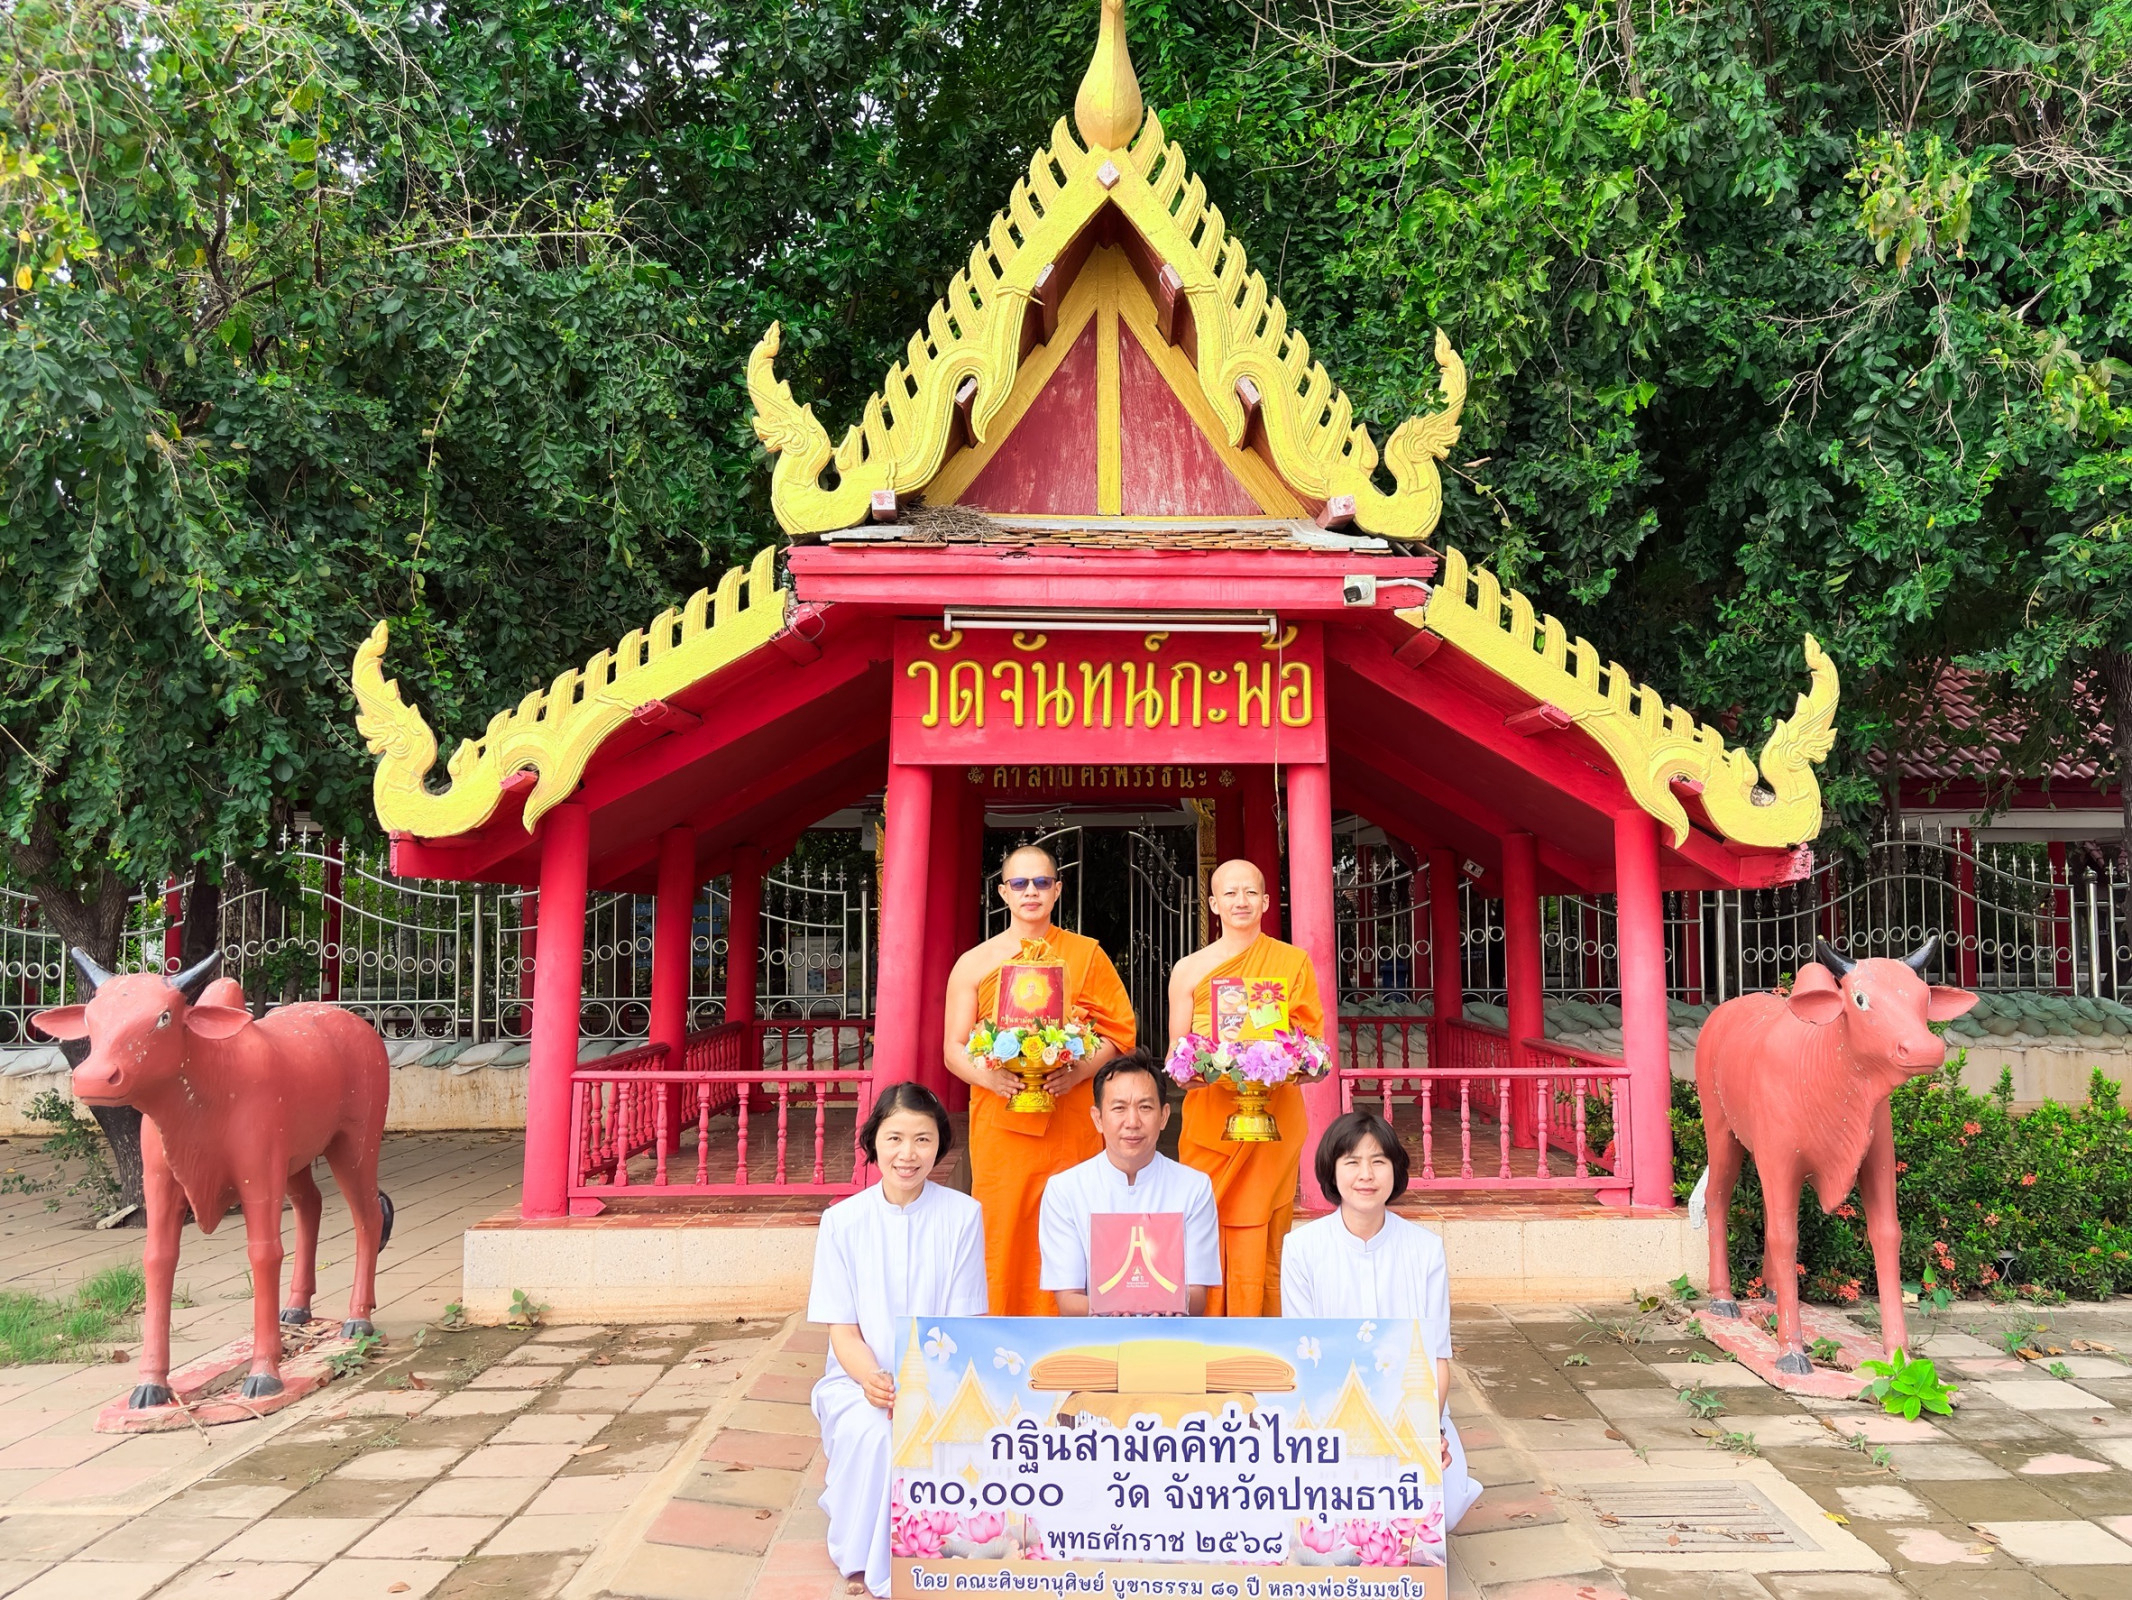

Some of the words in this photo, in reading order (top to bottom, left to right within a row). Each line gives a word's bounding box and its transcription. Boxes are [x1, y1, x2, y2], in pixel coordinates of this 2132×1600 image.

[907, 625, 1313, 729] วัดจันทน์กะพ้อ
[991, 1410, 1340, 1473] กฐินสามัคคีทั่วไทย
[909, 1481, 1064, 1511] ๓๐,๐๐๐
[1107, 1471, 1149, 1508] วัด
[1163, 1471, 1424, 1523] จังหวัดปทุมธานี
[1047, 1523, 1185, 1558] พุทธศักราช
[1196, 1529, 1283, 1553] ๒๕๖๘
[912, 1569, 948, 1588] โดย
[956, 1570, 1104, 1597] คณะศิษยานุศิษย์
[1112, 1578, 1203, 1599] บูชาธรรม
[1211, 1582, 1239, 1597] ๘๑
[1246, 1576, 1260, 1596] ปี
[1268, 1577, 1424, 1598] หลวงพ่อธัมมชโย
